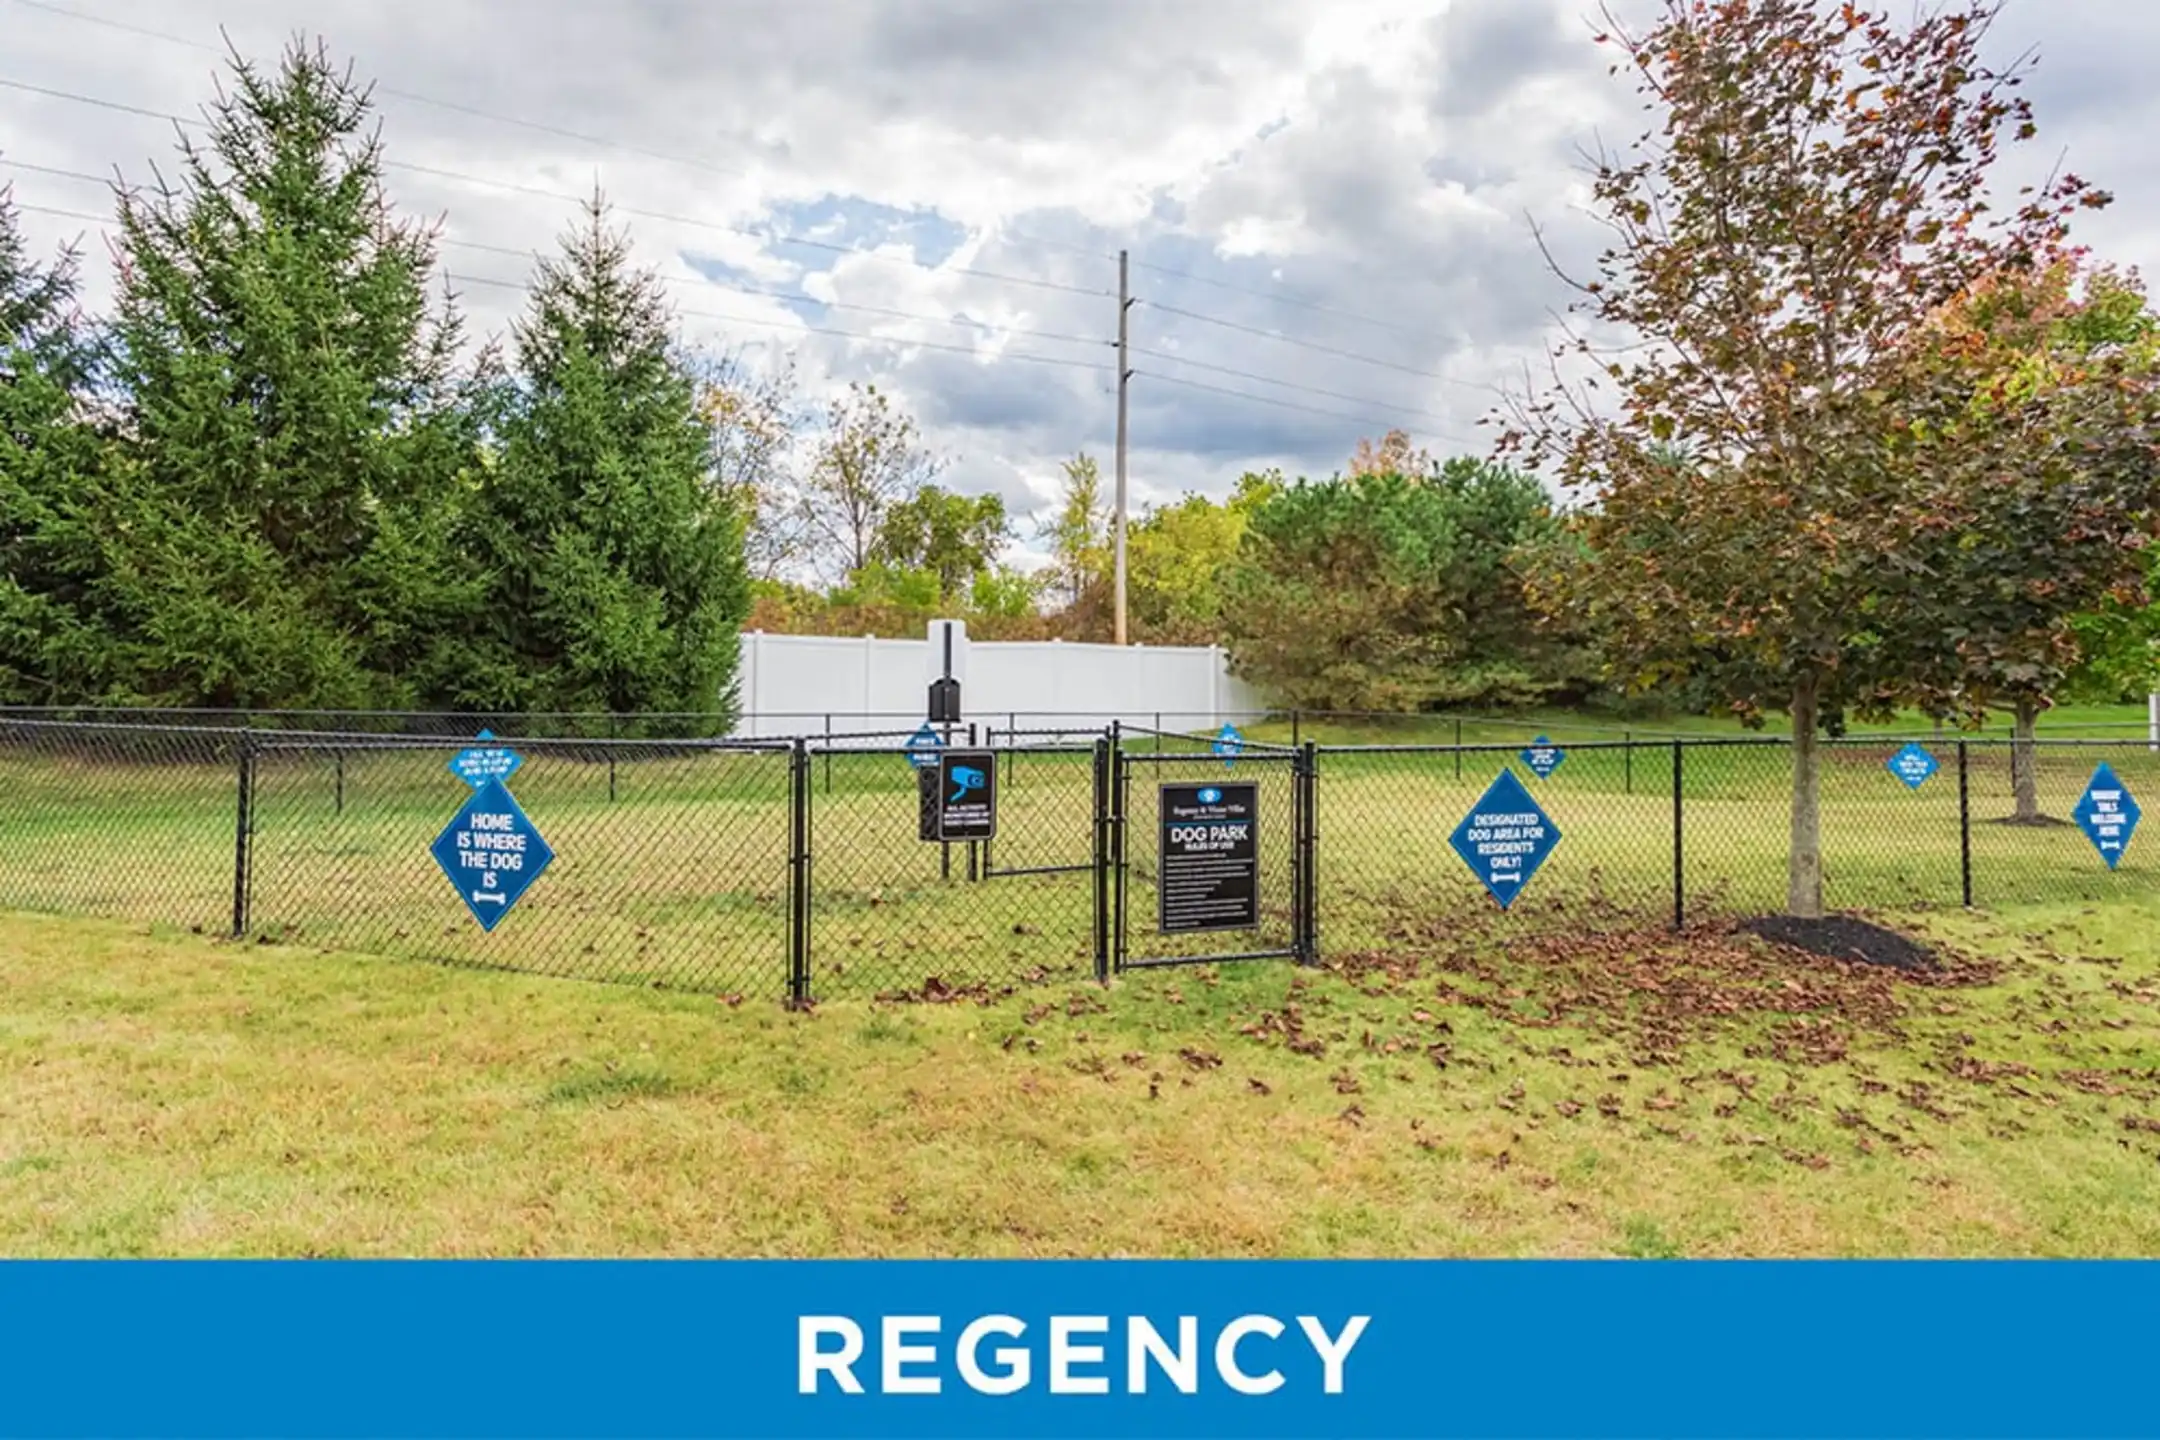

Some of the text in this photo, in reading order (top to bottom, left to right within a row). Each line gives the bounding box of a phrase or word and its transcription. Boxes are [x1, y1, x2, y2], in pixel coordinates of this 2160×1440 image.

[471, 813, 514, 831] HOME
[1474, 813, 1539, 827] DESIGNATED
[457, 831, 527, 851] IS WHERE
[1171, 824, 1249, 843] DOG PARK
[1468, 826, 1544, 842] DOG AREA FOR
[1477, 841, 1535, 855] RESIDENTS
[459, 851, 523, 870] THE DOG
[482, 872, 497, 888] IS
